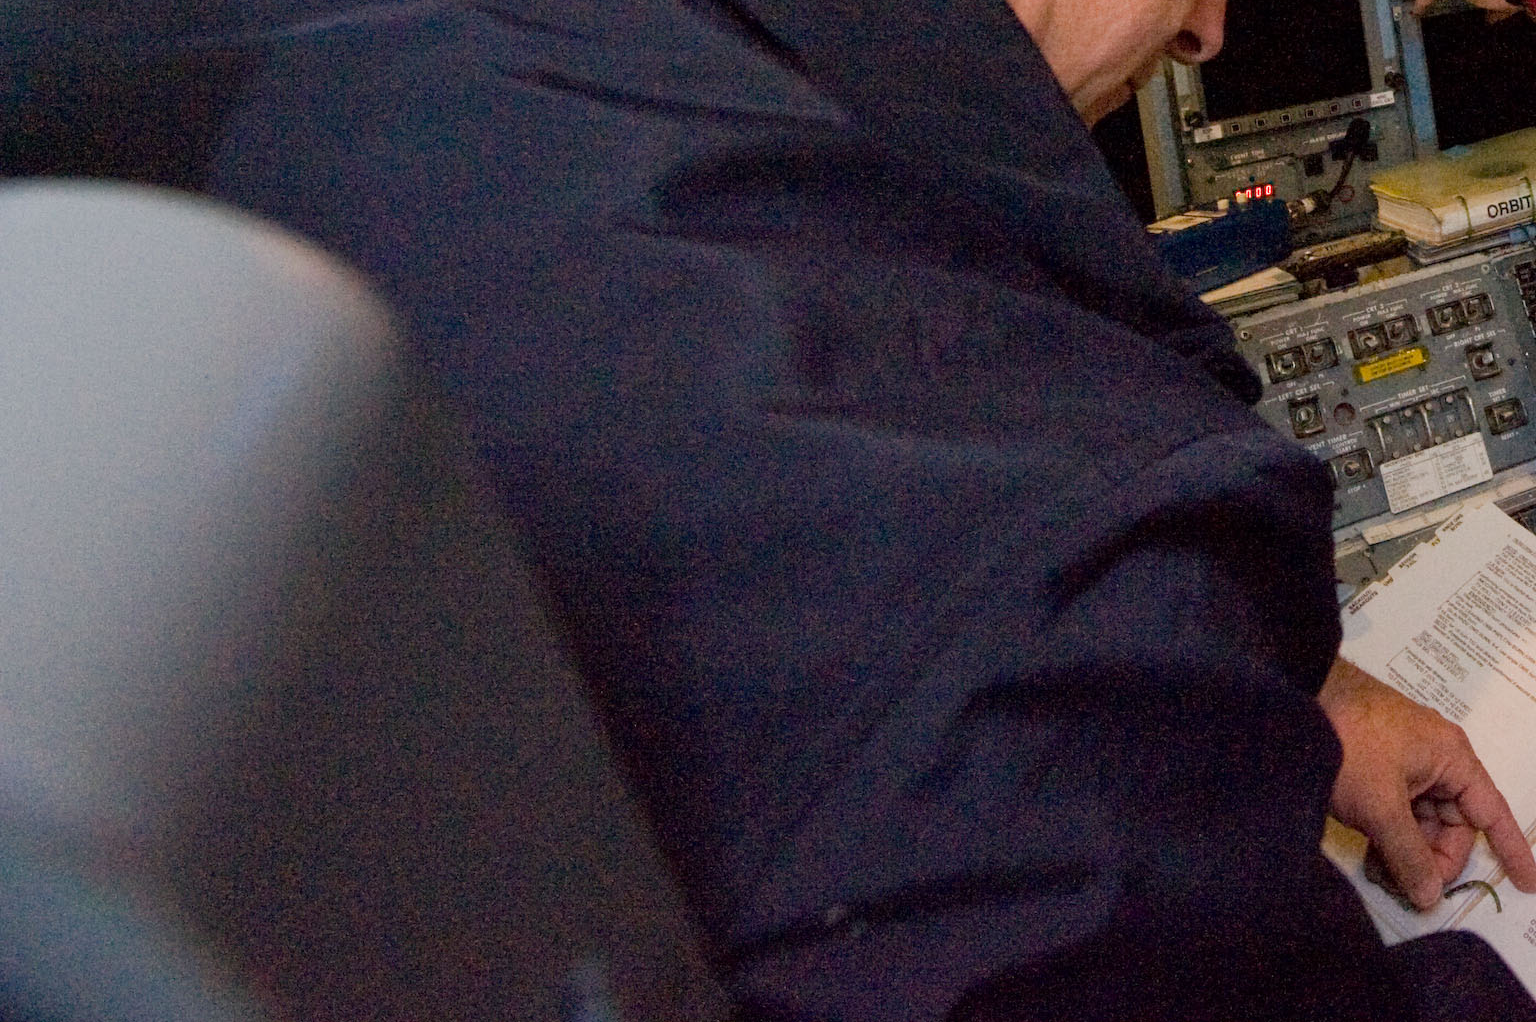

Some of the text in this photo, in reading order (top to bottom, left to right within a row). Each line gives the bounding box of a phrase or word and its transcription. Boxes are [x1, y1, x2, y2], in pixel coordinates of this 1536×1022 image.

[1487, 194, 1532, 219] ORBIT
[1441, 284, 1454, 292] CRT
[1365, 305, 1379, 313] CRT
[1284, 328, 1298, 336] CRT
[1453, 333, 1485, 347] RIGHT CRT
[1277, 387, 1308, 400] LEFT CRT
[1396, 385, 1429, 399] TIMER SET
[1326, 434, 1348, 444] TIMER
